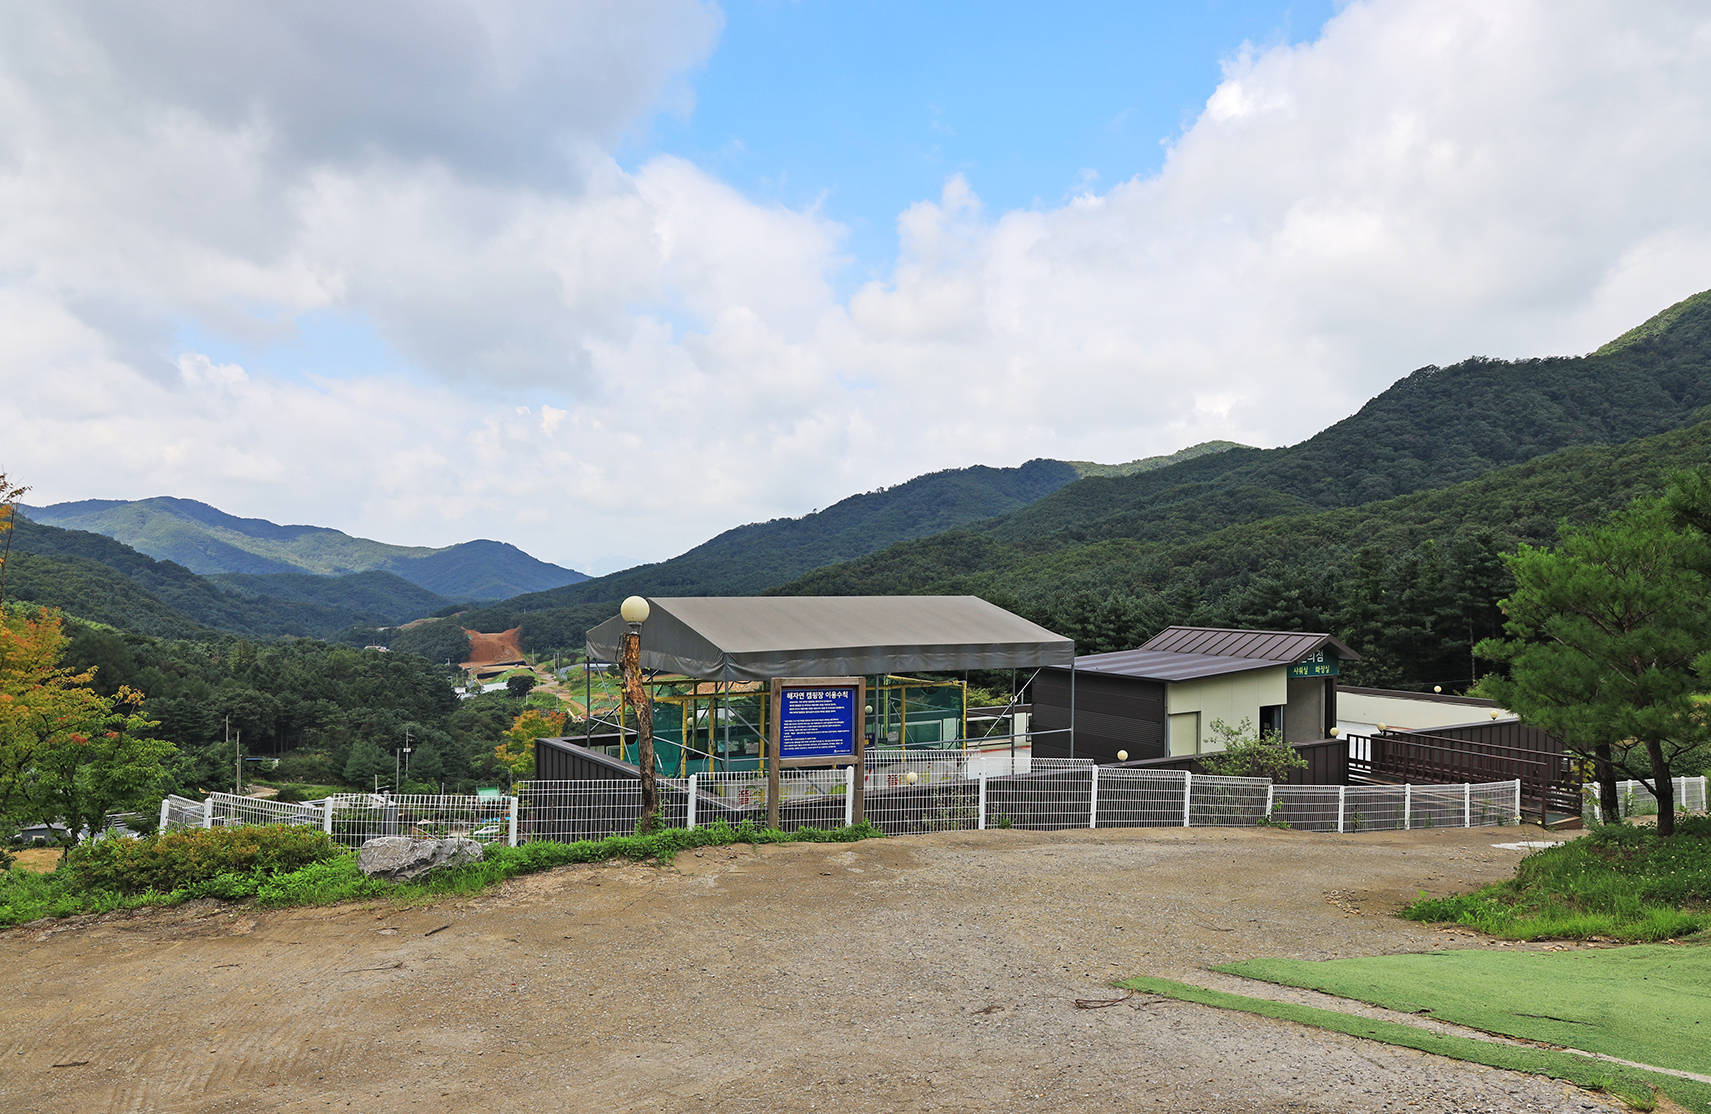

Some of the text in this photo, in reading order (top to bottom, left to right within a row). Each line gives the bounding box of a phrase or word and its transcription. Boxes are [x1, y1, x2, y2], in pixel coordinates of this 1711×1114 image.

[1302, 650, 1324, 663] 의점
[1315, 665, 1330, 674] 화장실
[787, 690, 849, 700] 해자연 캠핑장 이용수칙
